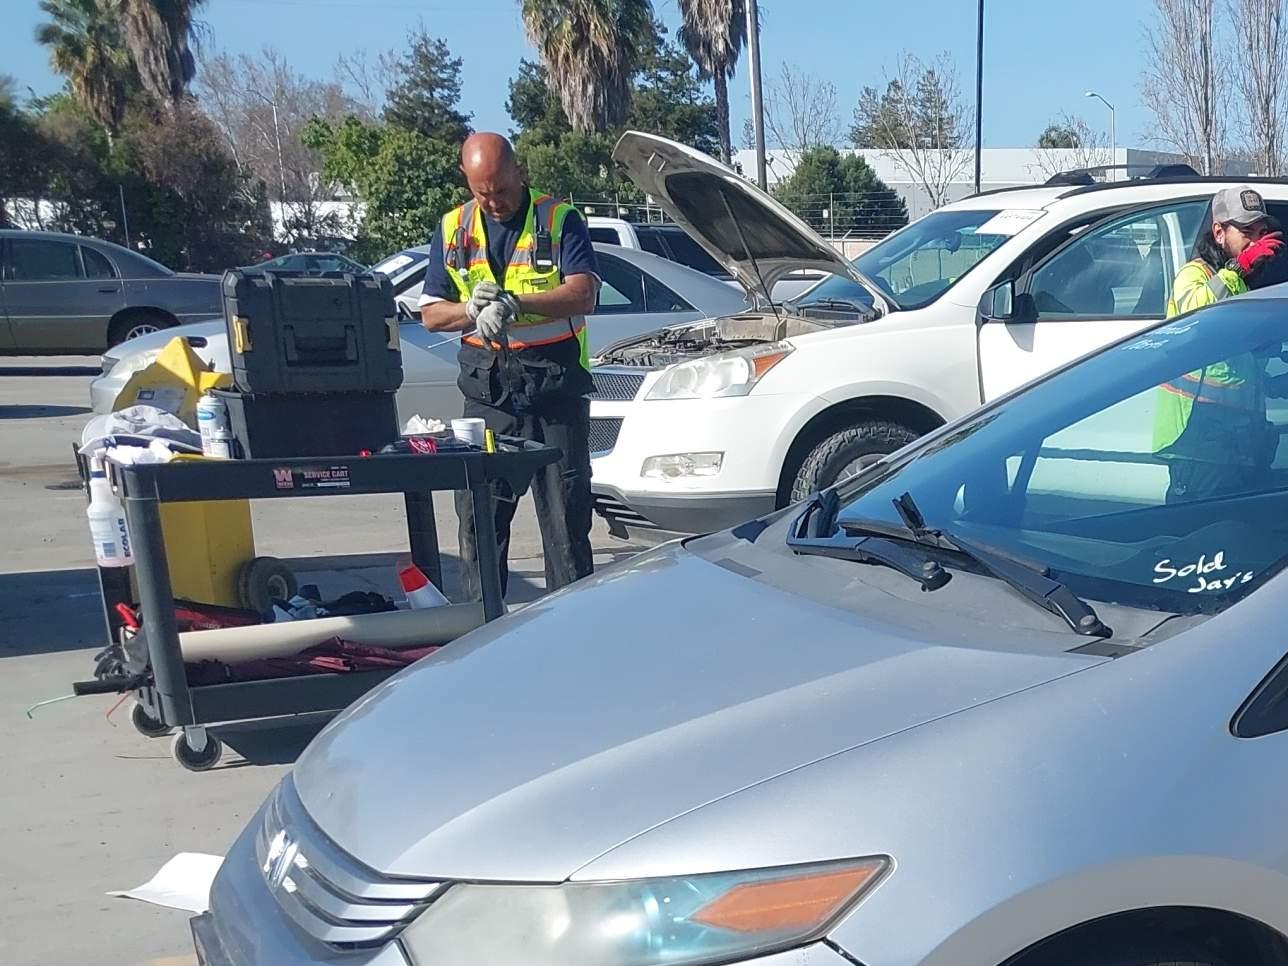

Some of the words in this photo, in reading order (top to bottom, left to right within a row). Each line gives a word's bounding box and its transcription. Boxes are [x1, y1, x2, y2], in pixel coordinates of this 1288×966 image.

[304, 471, 331, 479] SERVICE
[331, 470, 349, 478] CART
[118, 518, 131, 558] ECOLAB
[1152, 551, 1227, 583] Sold
[1187, 571, 1254, 593] Jay's
